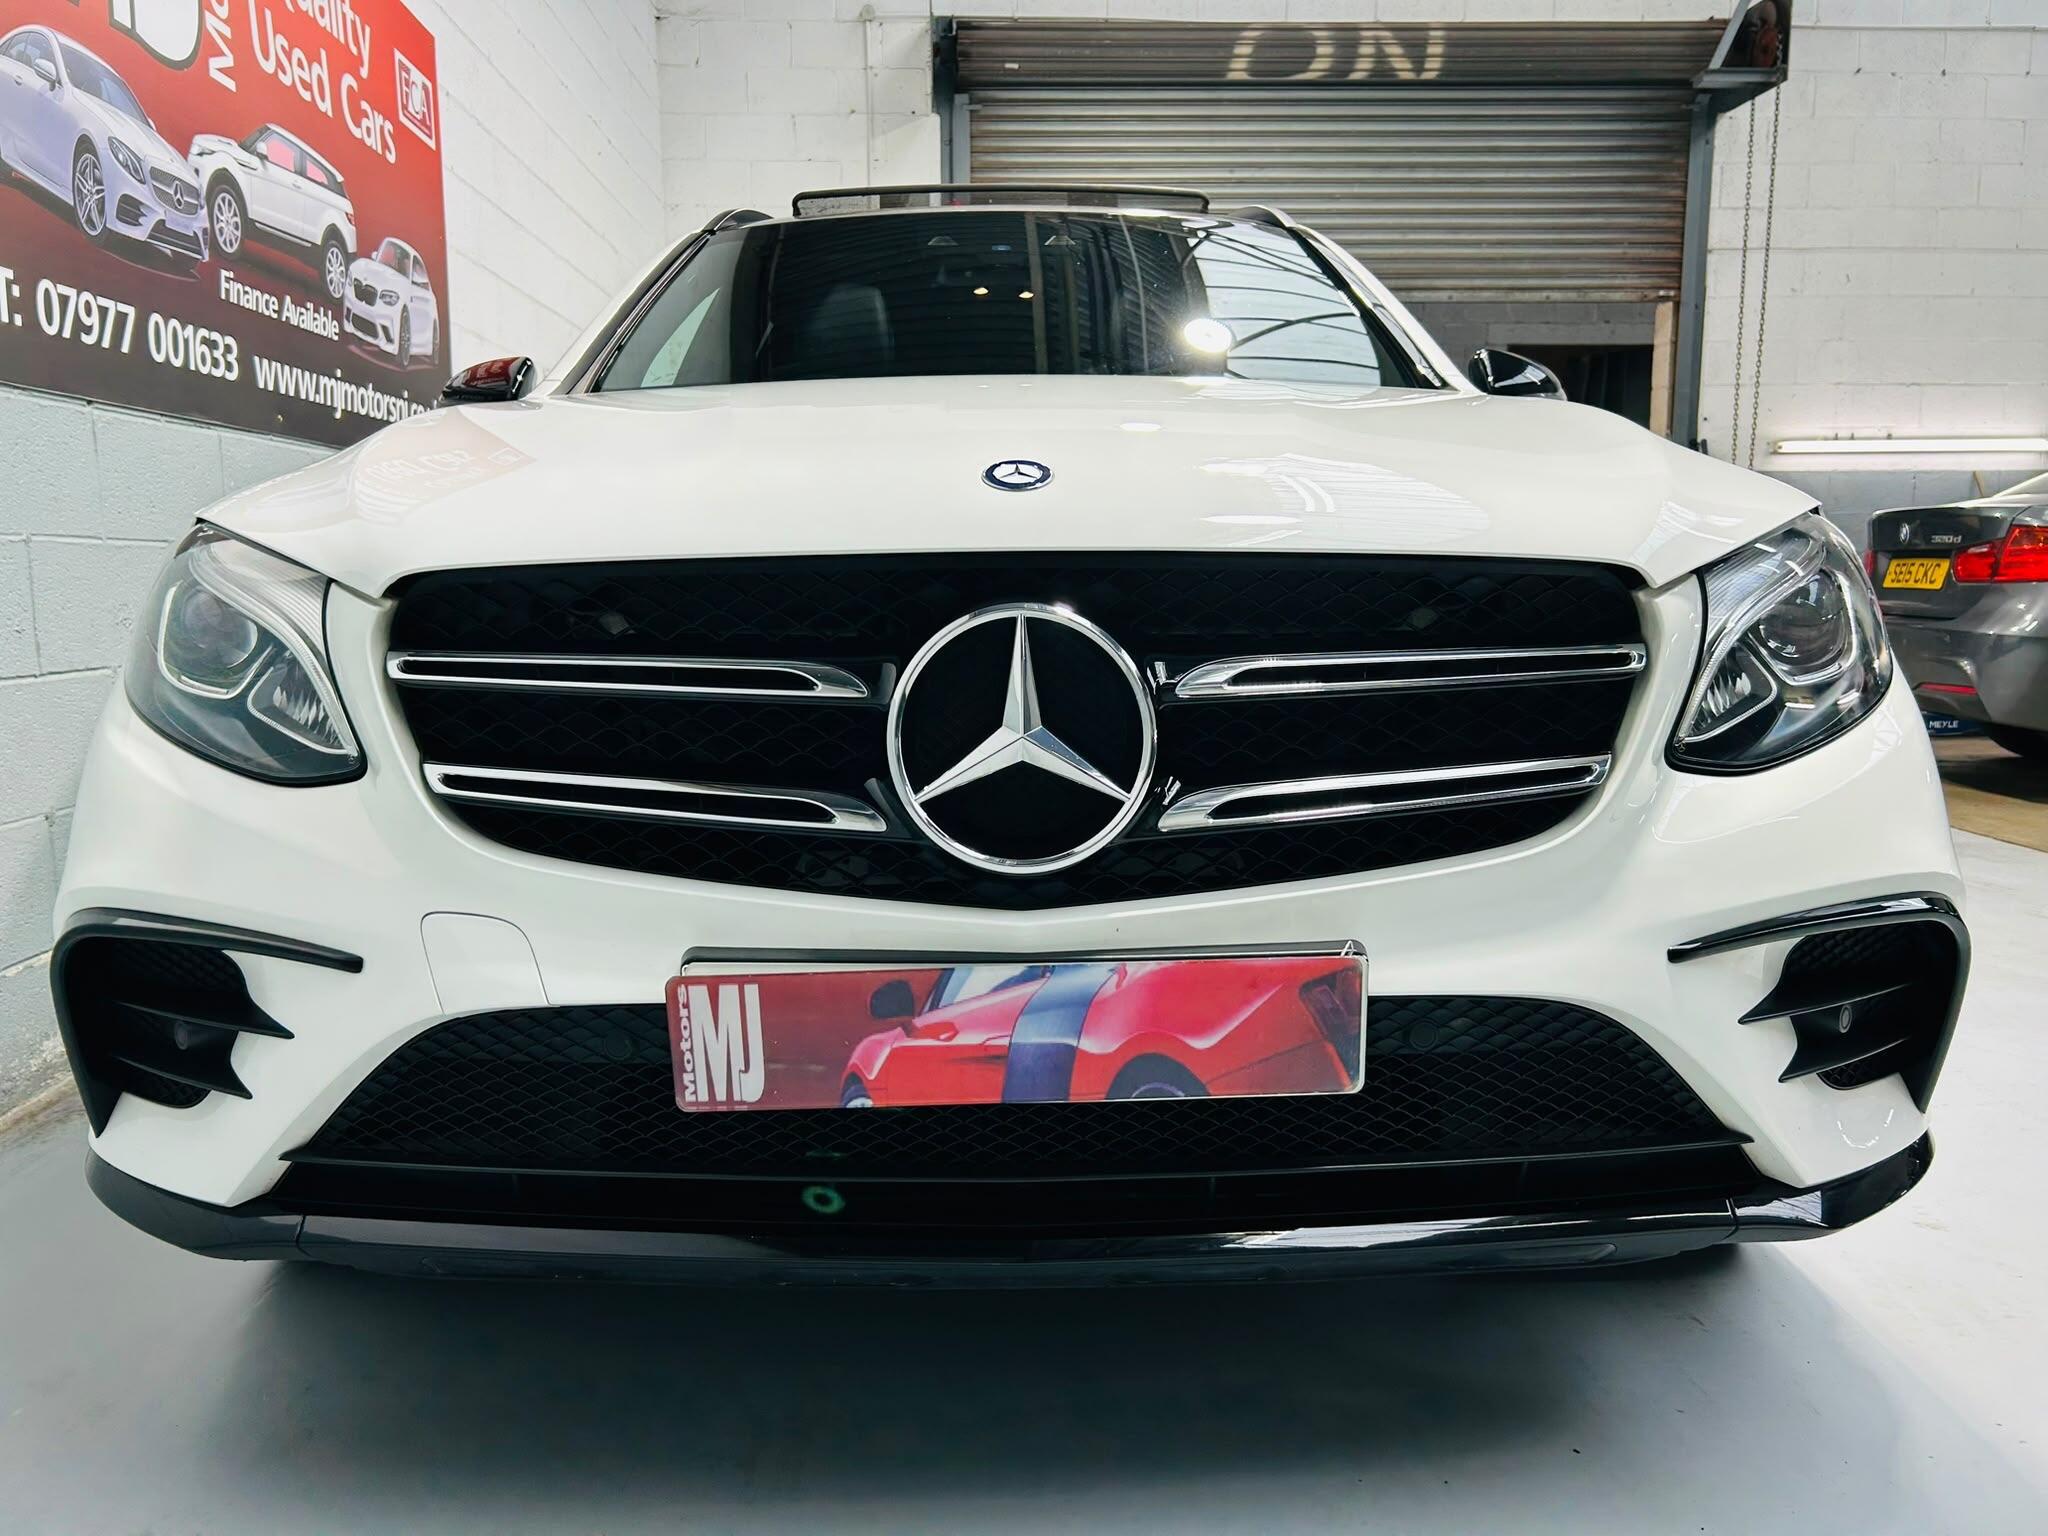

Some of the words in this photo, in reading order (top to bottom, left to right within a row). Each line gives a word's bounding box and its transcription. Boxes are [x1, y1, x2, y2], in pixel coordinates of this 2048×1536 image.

[247, 0, 333, 118] Used
[341, 72, 396, 164] Cars
[0, 266, 22, 327] T:
[36, 278, 136, 354] 07977
[148, 312, 239, 381] 001633
[219, 268, 279, 319] Finance
[281, 294, 339, 341] Available
[1890, 562, 1916, 584] SE15
[1914, 562, 1941, 584] CKC
[1931, 535, 1962, 543] 320d
[1929, 720, 1960, 729] MEYLE
[678, 983, 697, 1103] Motors
[687, 983, 765, 1103] MJ
